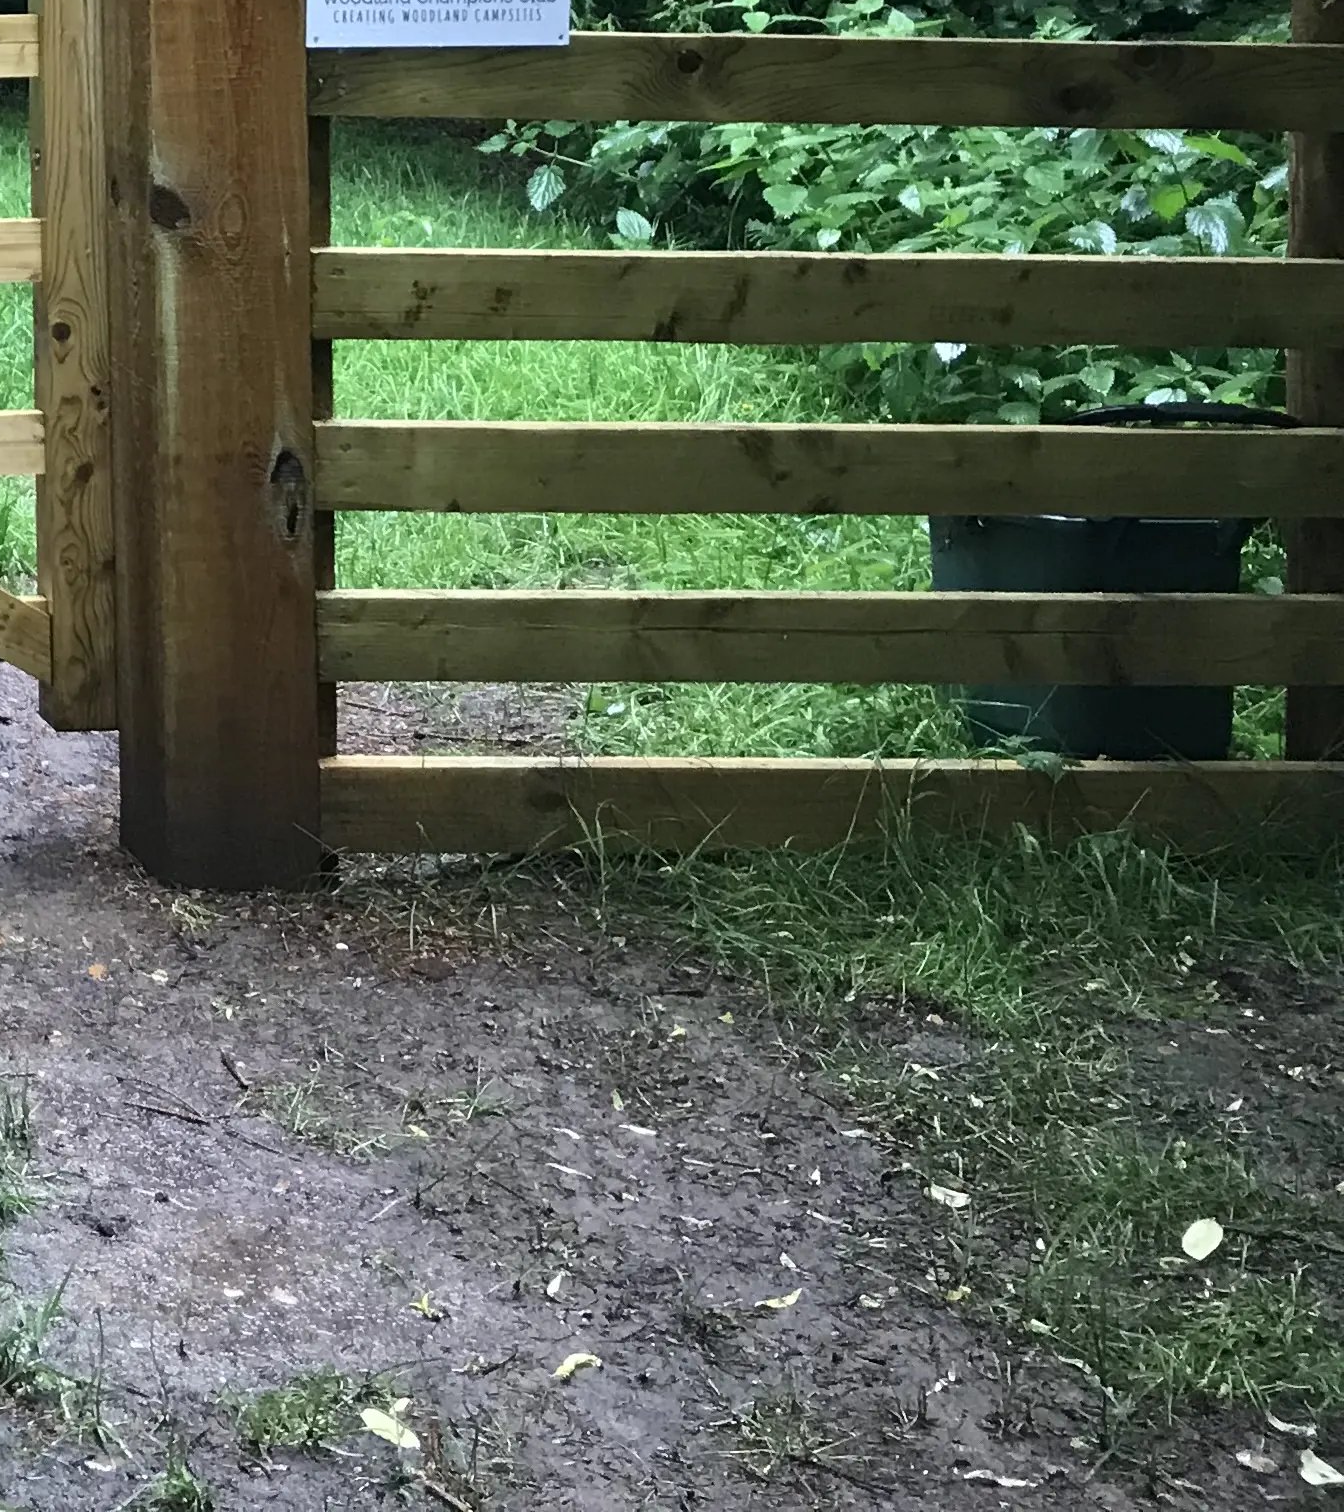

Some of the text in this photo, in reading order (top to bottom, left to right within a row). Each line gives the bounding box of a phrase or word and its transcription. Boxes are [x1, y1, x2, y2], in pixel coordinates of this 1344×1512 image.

[333, 7, 542, 24] CREATING WOODLAND CAMPSITES
